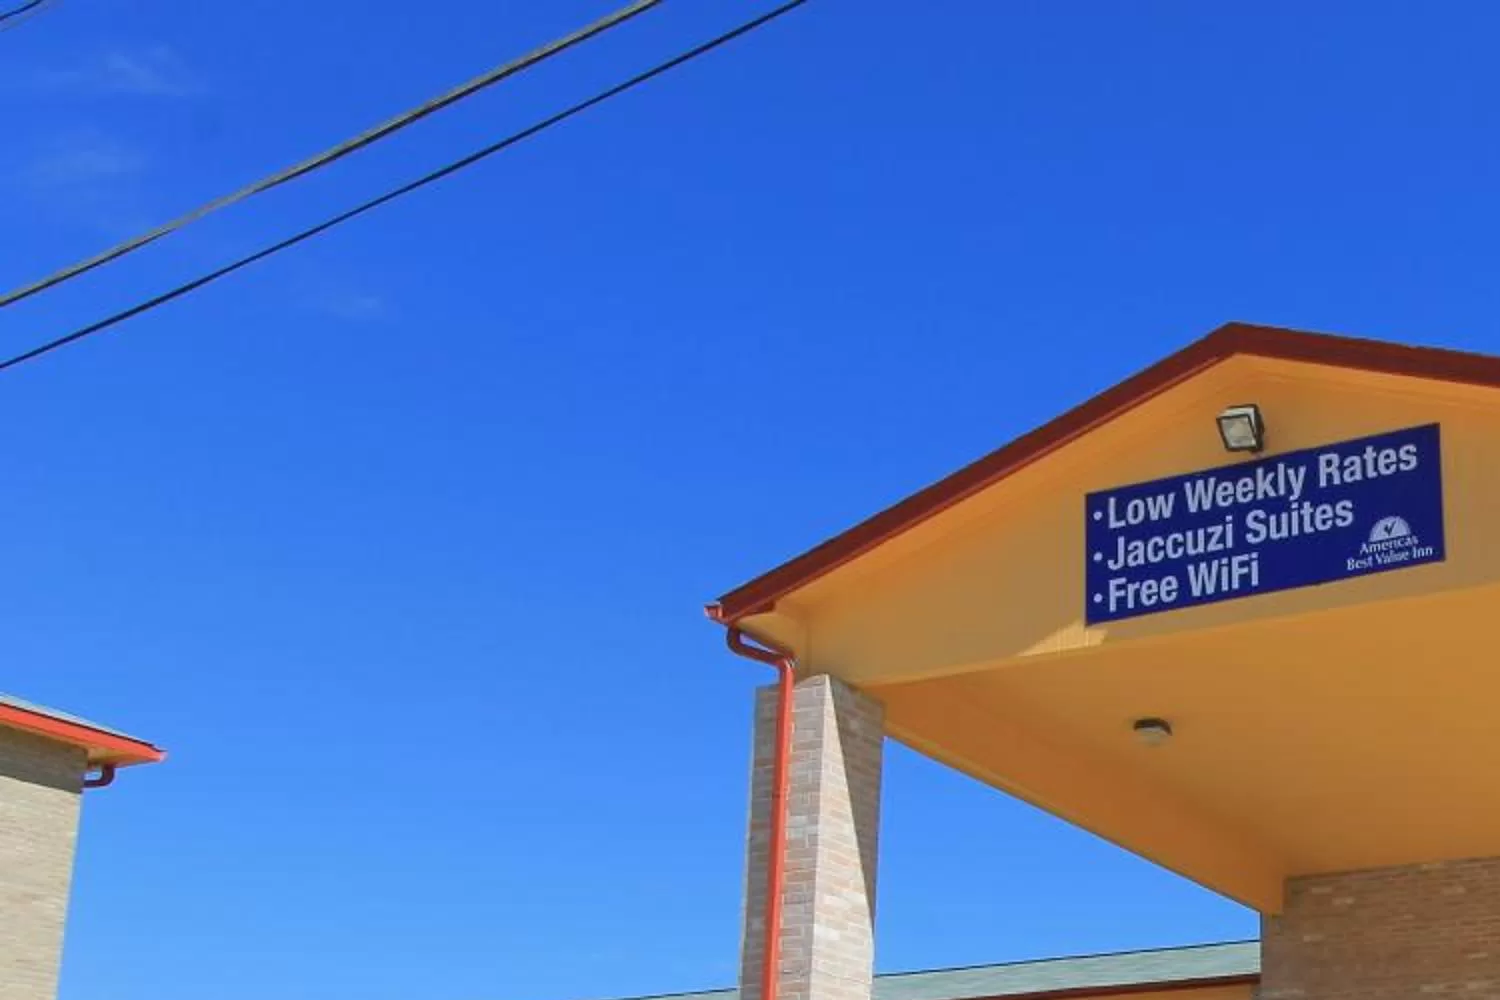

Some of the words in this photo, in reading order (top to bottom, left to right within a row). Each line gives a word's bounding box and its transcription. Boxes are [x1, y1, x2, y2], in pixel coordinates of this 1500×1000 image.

[1108, 493, 1176, 529] Low
[1184, 462, 1307, 513] Weekly
[1318, 444, 1418, 488] Rates
[1107, 515, 1233, 571] Jaccuzi
[1245, 500, 1354, 543] Suites
[1360, 535, 1419, 555] Americas
[1412, 546, 1433, 558] Inn
[1108, 575, 1179, 612] Free
[1187, 552, 1260, 597] WiFi
